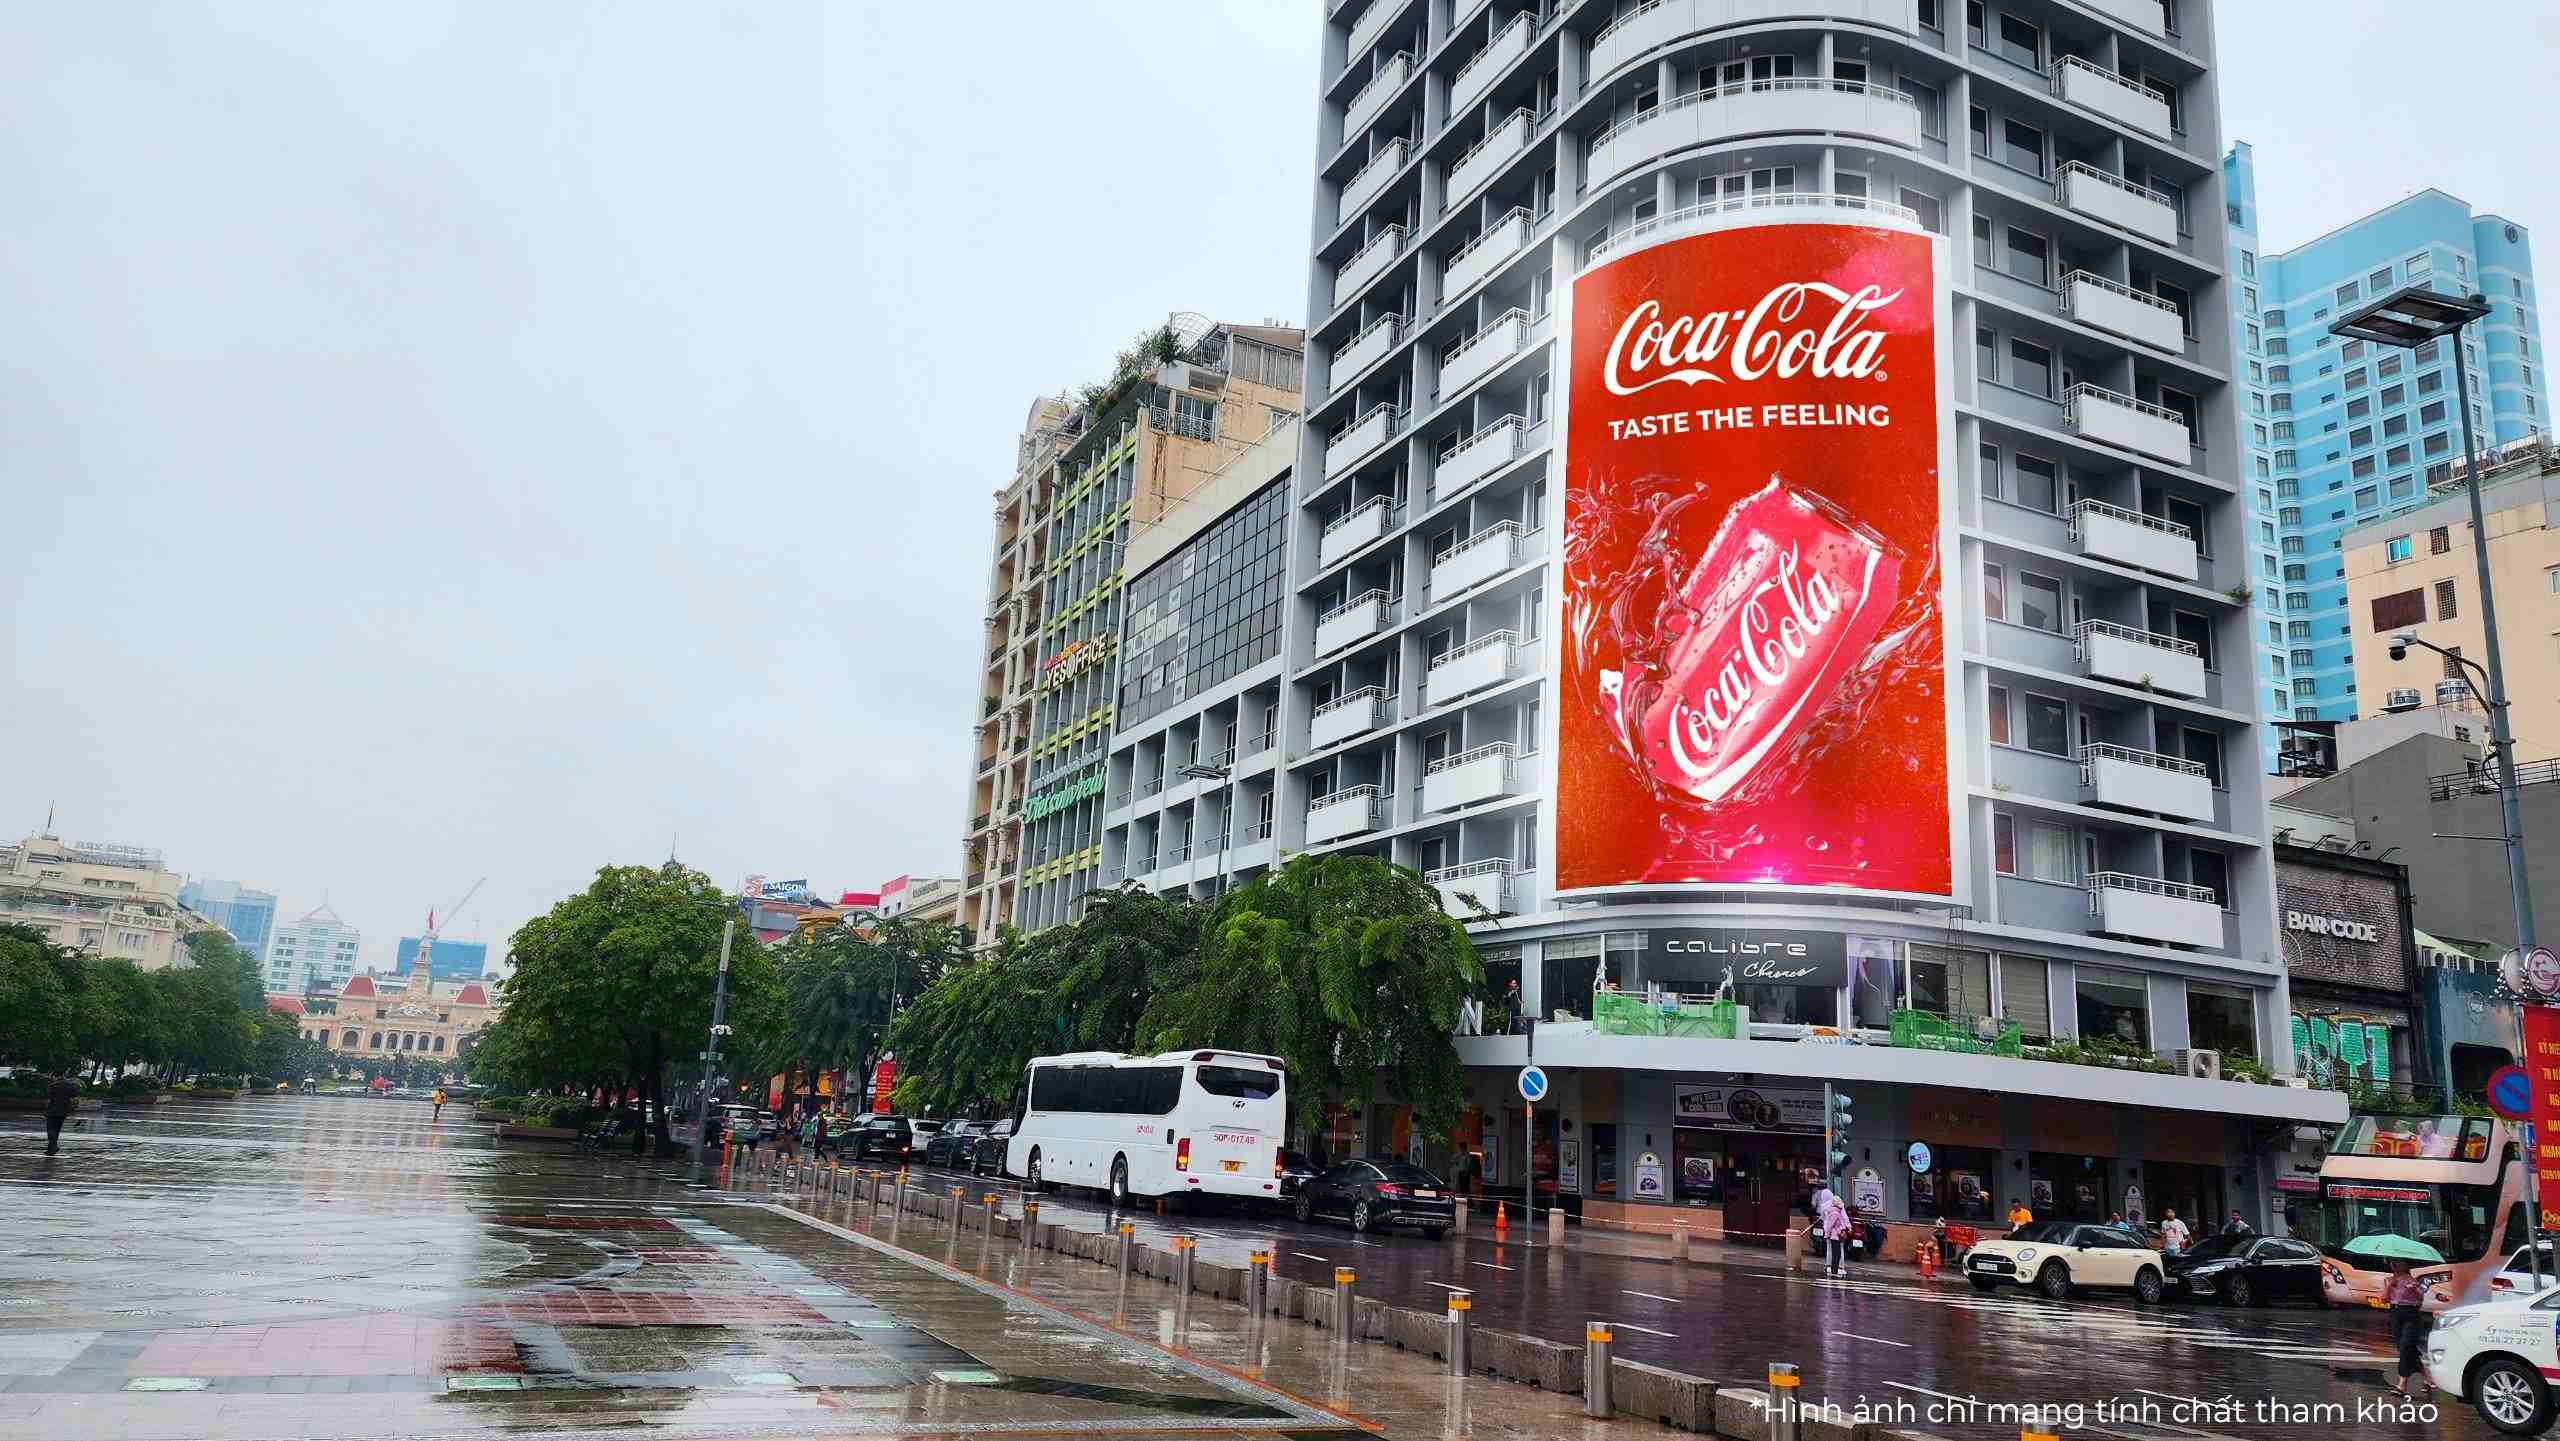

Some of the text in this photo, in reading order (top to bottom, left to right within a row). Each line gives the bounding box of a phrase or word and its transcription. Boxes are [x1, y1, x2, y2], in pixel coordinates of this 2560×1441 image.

[1603, 282, 1904, 395] Coca-Cola
[1608, 403, 1890, 441] TASTE THE FEELING
[1668, 535, 1840, 777] Coca-Cola
